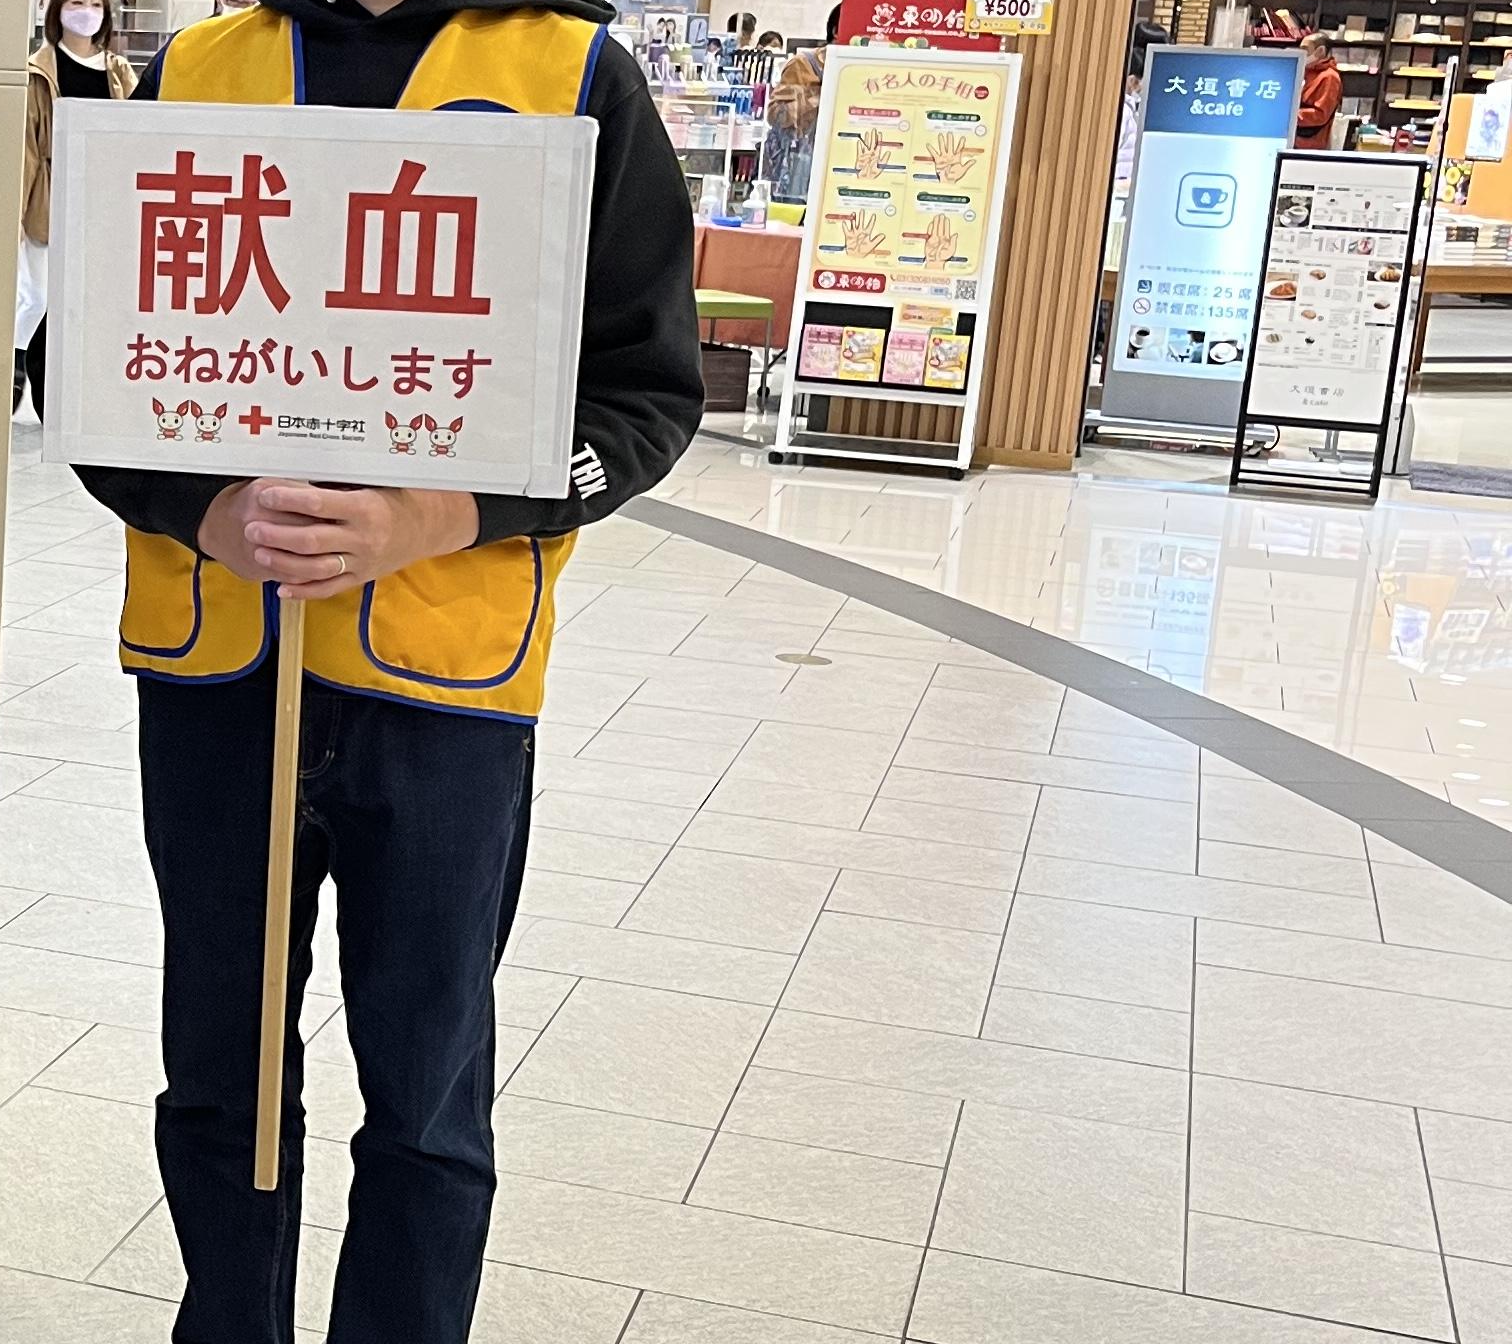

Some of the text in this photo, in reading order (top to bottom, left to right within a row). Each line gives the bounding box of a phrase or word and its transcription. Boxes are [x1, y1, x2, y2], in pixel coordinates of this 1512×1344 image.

[1164, 76, 1282, 99] 大垣書店
[1189, 99, 1244, 117] &cafe
[136, 151, 491, 316] 献血
[125, 333, 493, 399] おねがいします
[277, 415, 366, 433] 日本赤十字社
